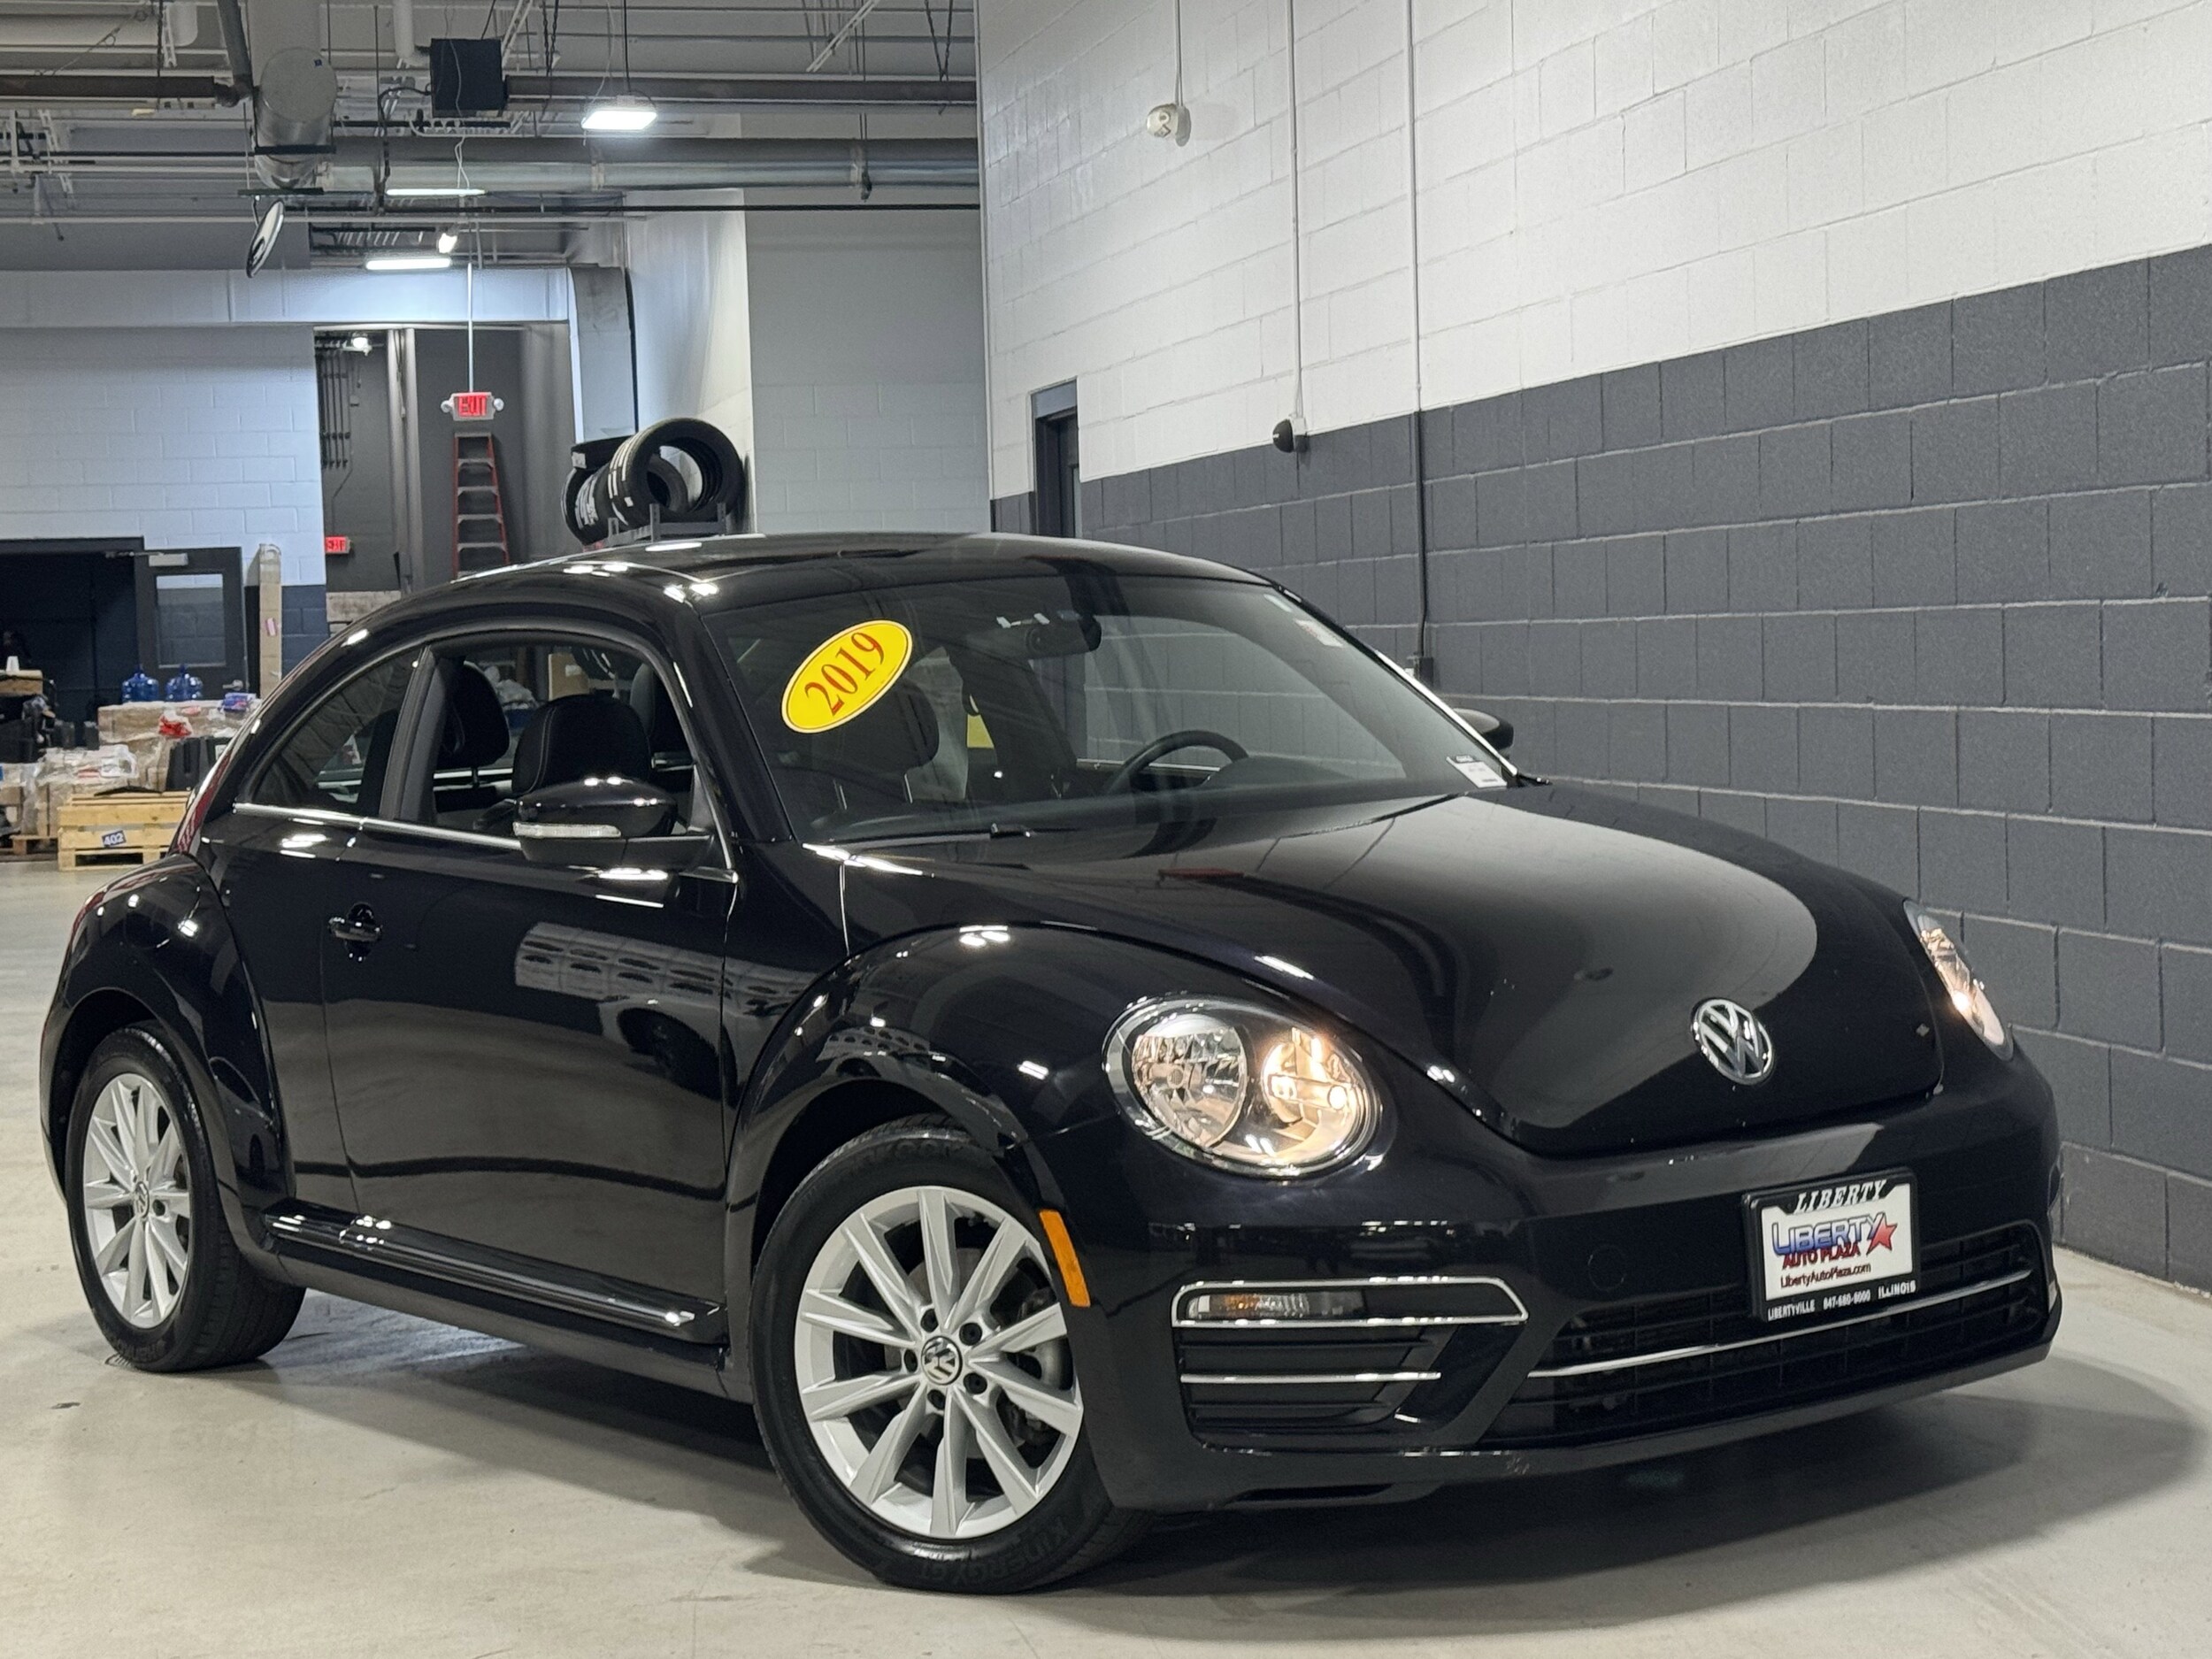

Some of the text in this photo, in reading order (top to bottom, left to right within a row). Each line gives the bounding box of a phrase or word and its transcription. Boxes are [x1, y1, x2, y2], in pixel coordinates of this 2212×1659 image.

[458, 396, 487, 417] EXIT
[804, 632, 885, 717] 2019
[104, 833, 125, 846] 402
[1793, 1179, 1887, 1215] LIBERTY
[1771, 1211, 1886, 1256] LIBERTY
[1782, 1241, 1861, 1271] AUTO PLAZA
[1780, 1263, 1872, 1289] LibertyAutoPlaza.com
[1767, 1299, 1816, 1322] LIBERTYVILLE
[1878, 1279, 1916, 1300] ILLINOIS
